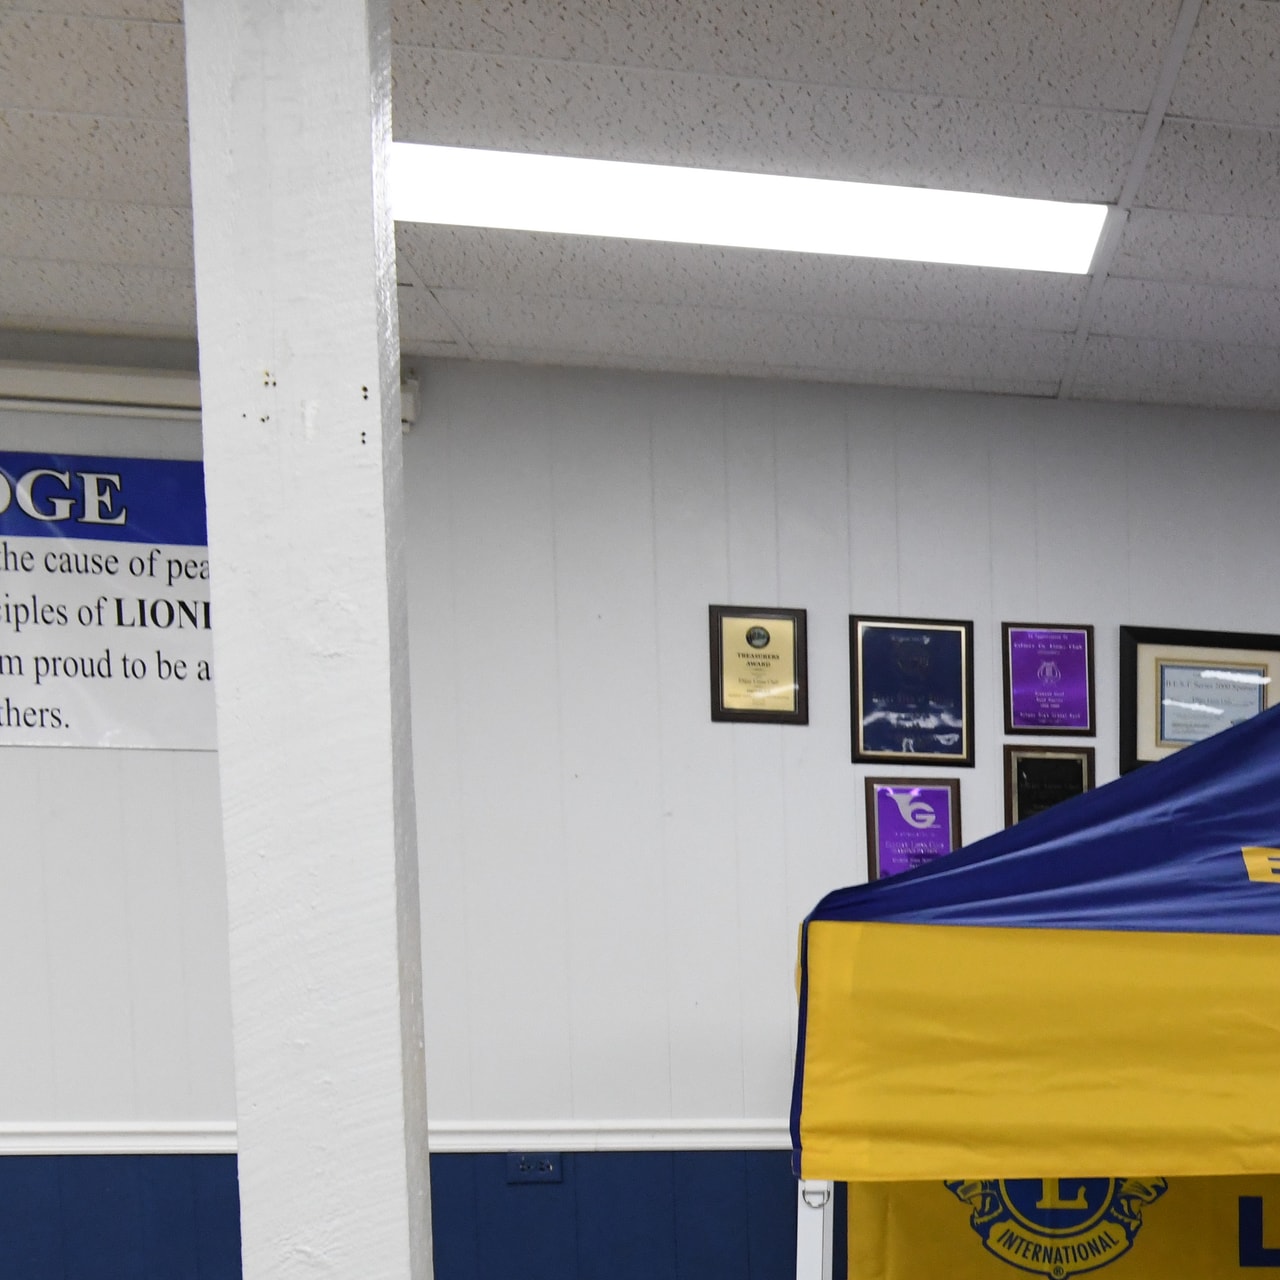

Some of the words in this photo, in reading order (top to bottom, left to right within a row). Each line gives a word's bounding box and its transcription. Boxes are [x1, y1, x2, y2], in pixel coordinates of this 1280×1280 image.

[0, 468, 127, 525] GE
[0, 541, 34, 572] he
[44, 550, 119, 575] cause
[129, 548, 161, 577] of
[0, 593, 68, 632] iples
[78, 596, 108, 626] of
[33, 649, 113, 685] proud
[122, 653, 147, 680] to
[156, 650, 188, 681] be
[197, 659, 212, 681] a
[997, 1228, 1120, 1265] INTERNATIONAL
